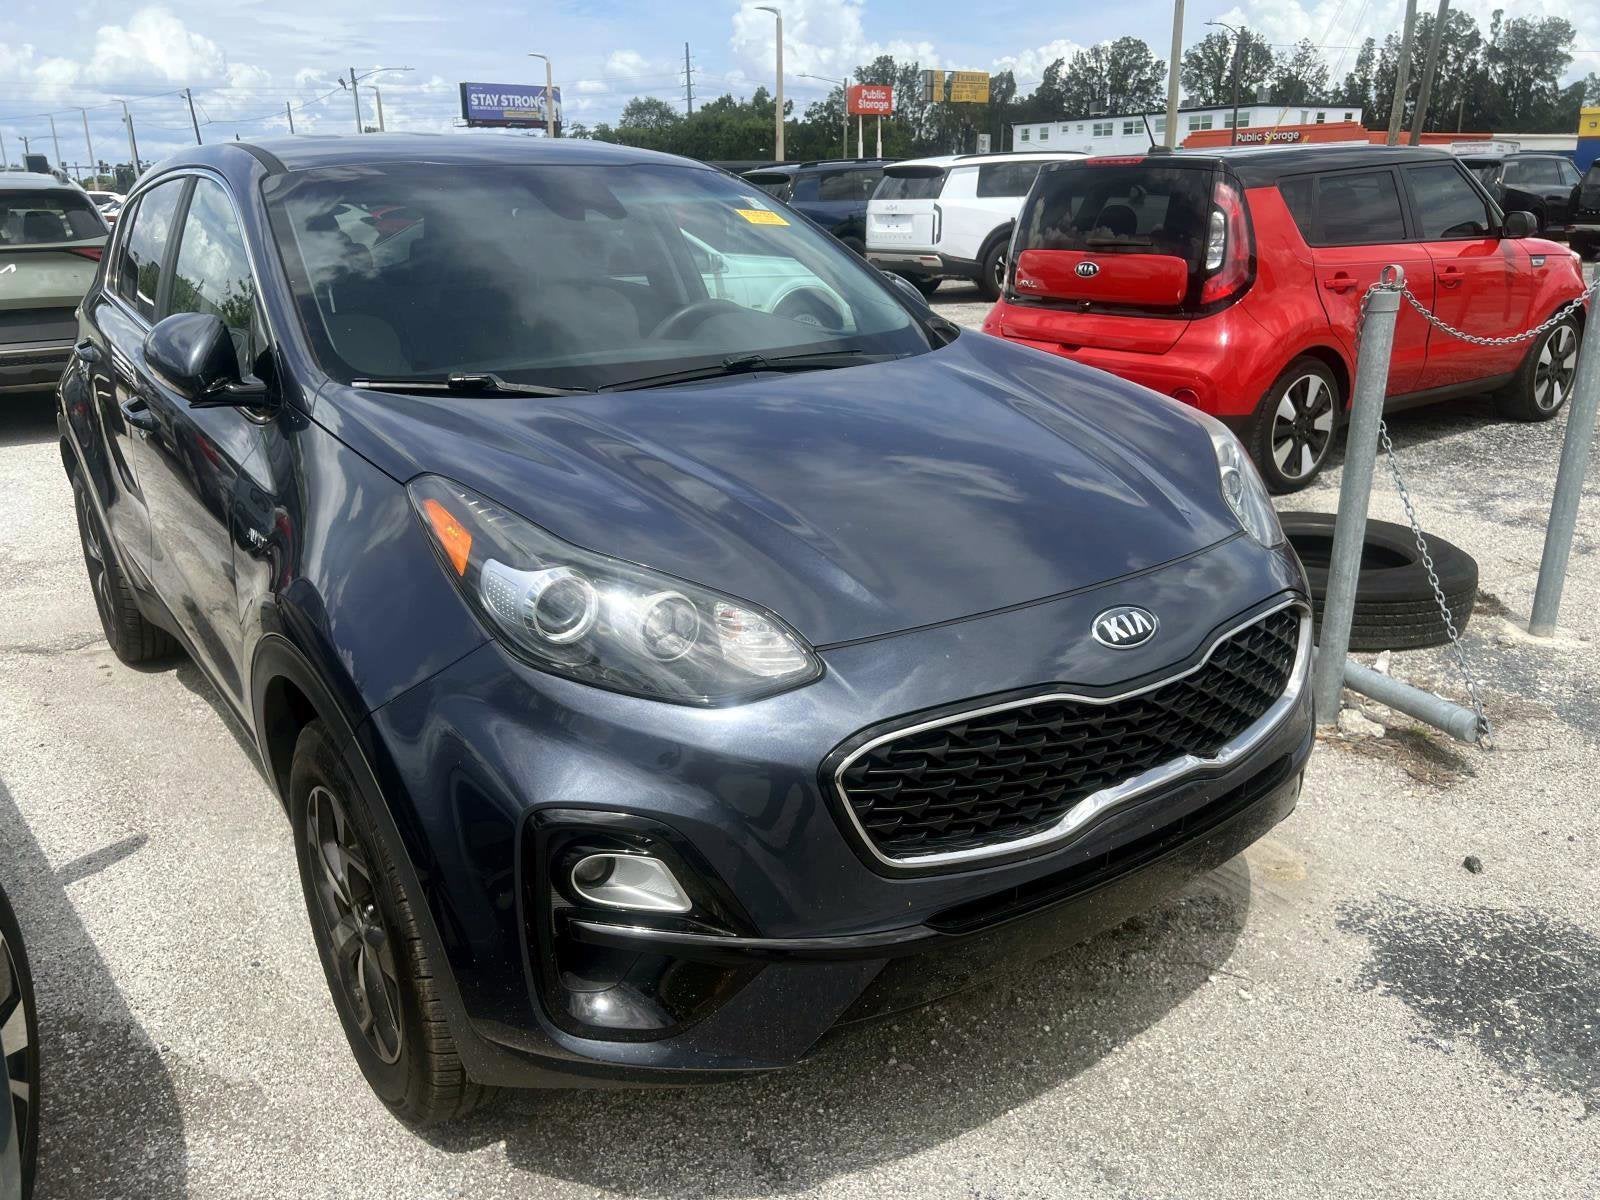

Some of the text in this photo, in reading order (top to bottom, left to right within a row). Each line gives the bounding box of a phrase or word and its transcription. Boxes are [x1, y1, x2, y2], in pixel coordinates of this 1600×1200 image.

[861, 89, 886, 99] Public
[471, 93, 500, 106] STAY
[500, 95, 546, 108] STRONG
[858, 99, 889, 111] Storage
[1236, 131, 1300, 142] Public Sorage
[1076, 263, 1095, 275] KIA
[1099, 611, 1153, 642] KIA
